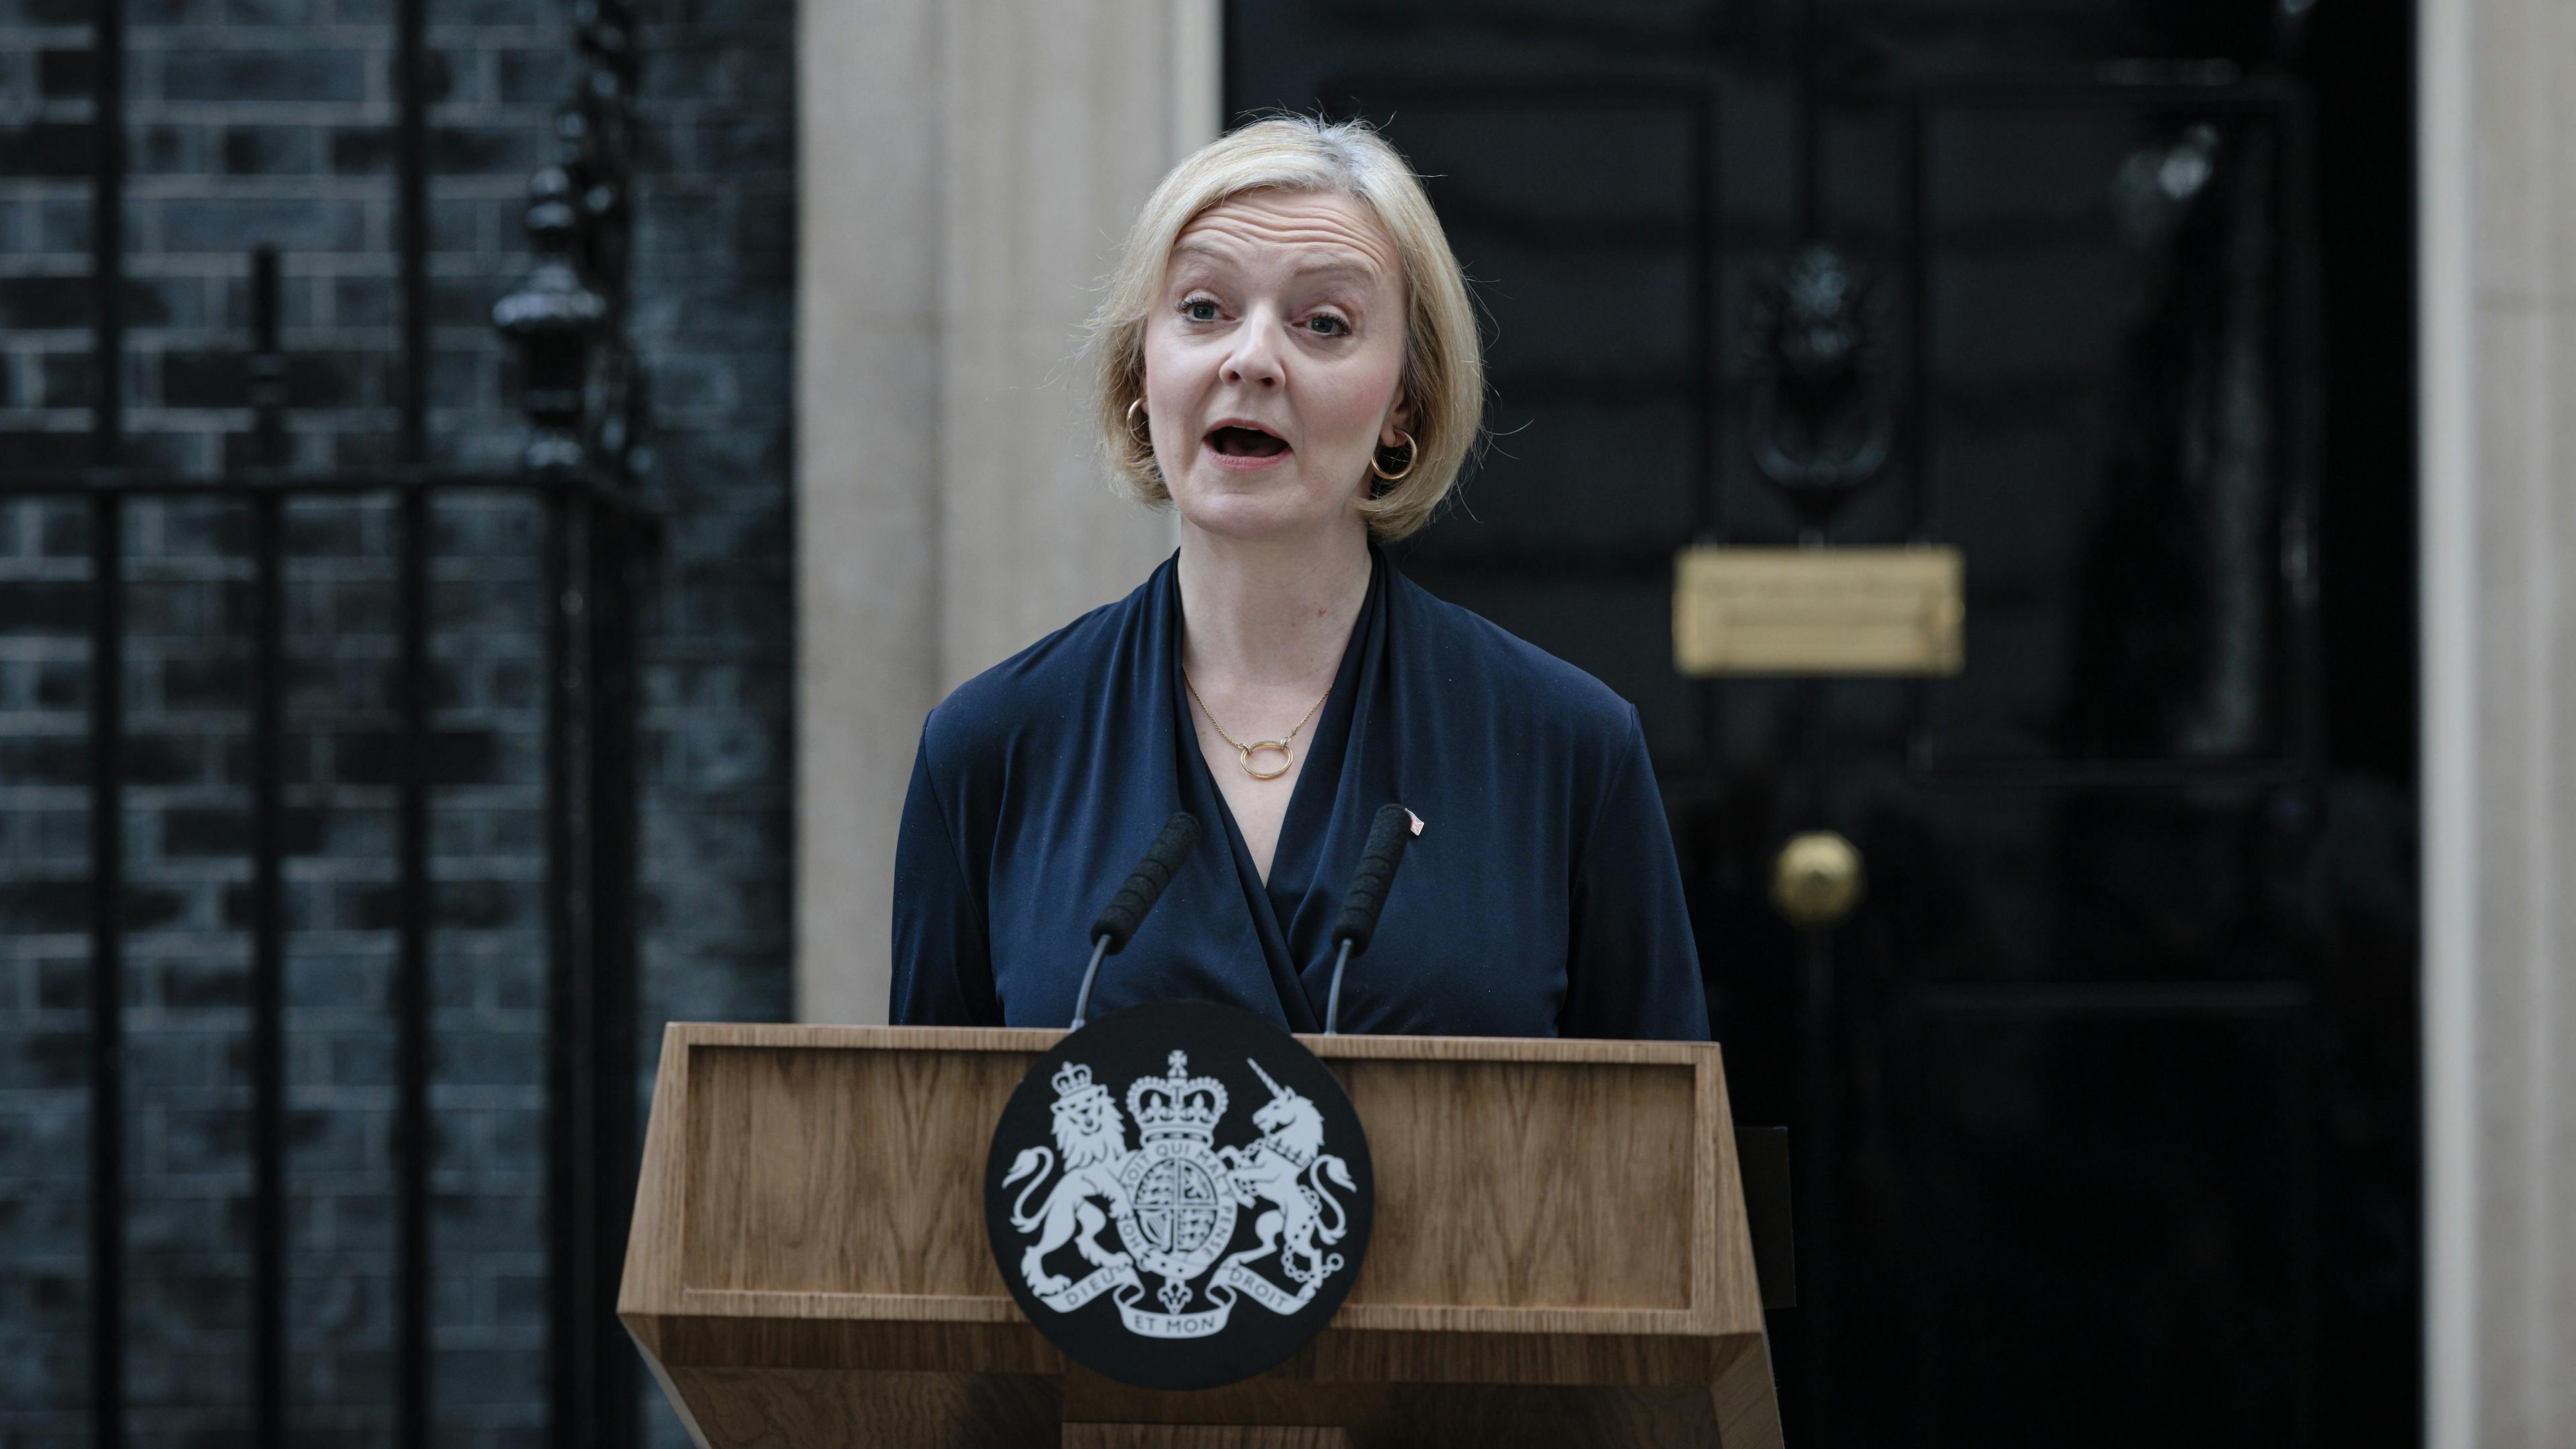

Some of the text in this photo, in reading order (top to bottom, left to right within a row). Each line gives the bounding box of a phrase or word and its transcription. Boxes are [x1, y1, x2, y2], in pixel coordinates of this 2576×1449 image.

[1156, 1142, 1190, 1157] QUI
[1203, 1205, 1233, 1258] PENSE
[1065, 1267, 1290, 1334] DIEU ET MON DROIT
